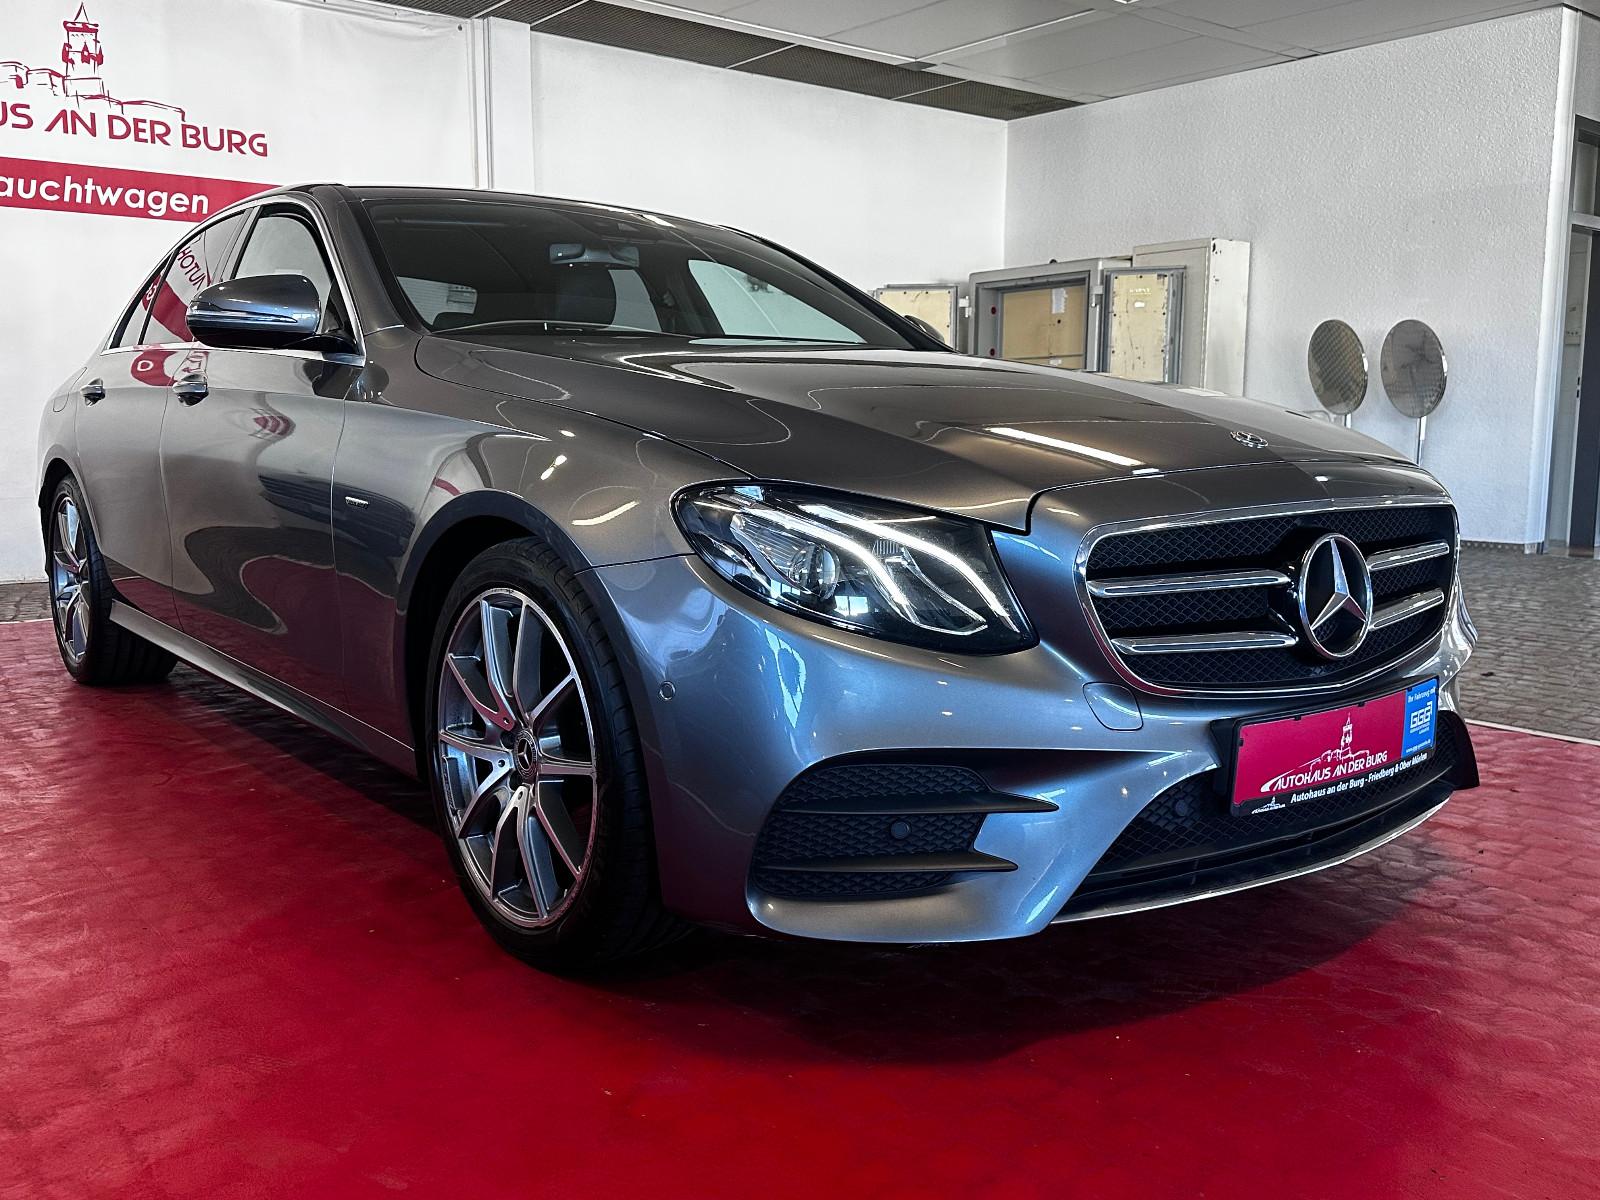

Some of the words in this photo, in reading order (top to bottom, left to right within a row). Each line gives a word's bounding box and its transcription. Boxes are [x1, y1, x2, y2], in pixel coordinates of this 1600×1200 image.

[44, 109, 97, 137] AN
[107, 114, 171, 146] DER
[181, 123, 268, 157] BURG
[1272, 767, 1331, 791] AUTOHAUS
[1332, 763, 1347, 778] AN
[1348, 757, 1365, 773] DER
[1366, 751, 1388, 767] BURG
[1290, 788, 1326, 803] Autohaus
[1327, 785, 1336, 795] an
[1336, 781, 1349, 792] der
[1349, 776, 1365, 788] Burg
[1368, 767, 1395, 782] Friedberg
